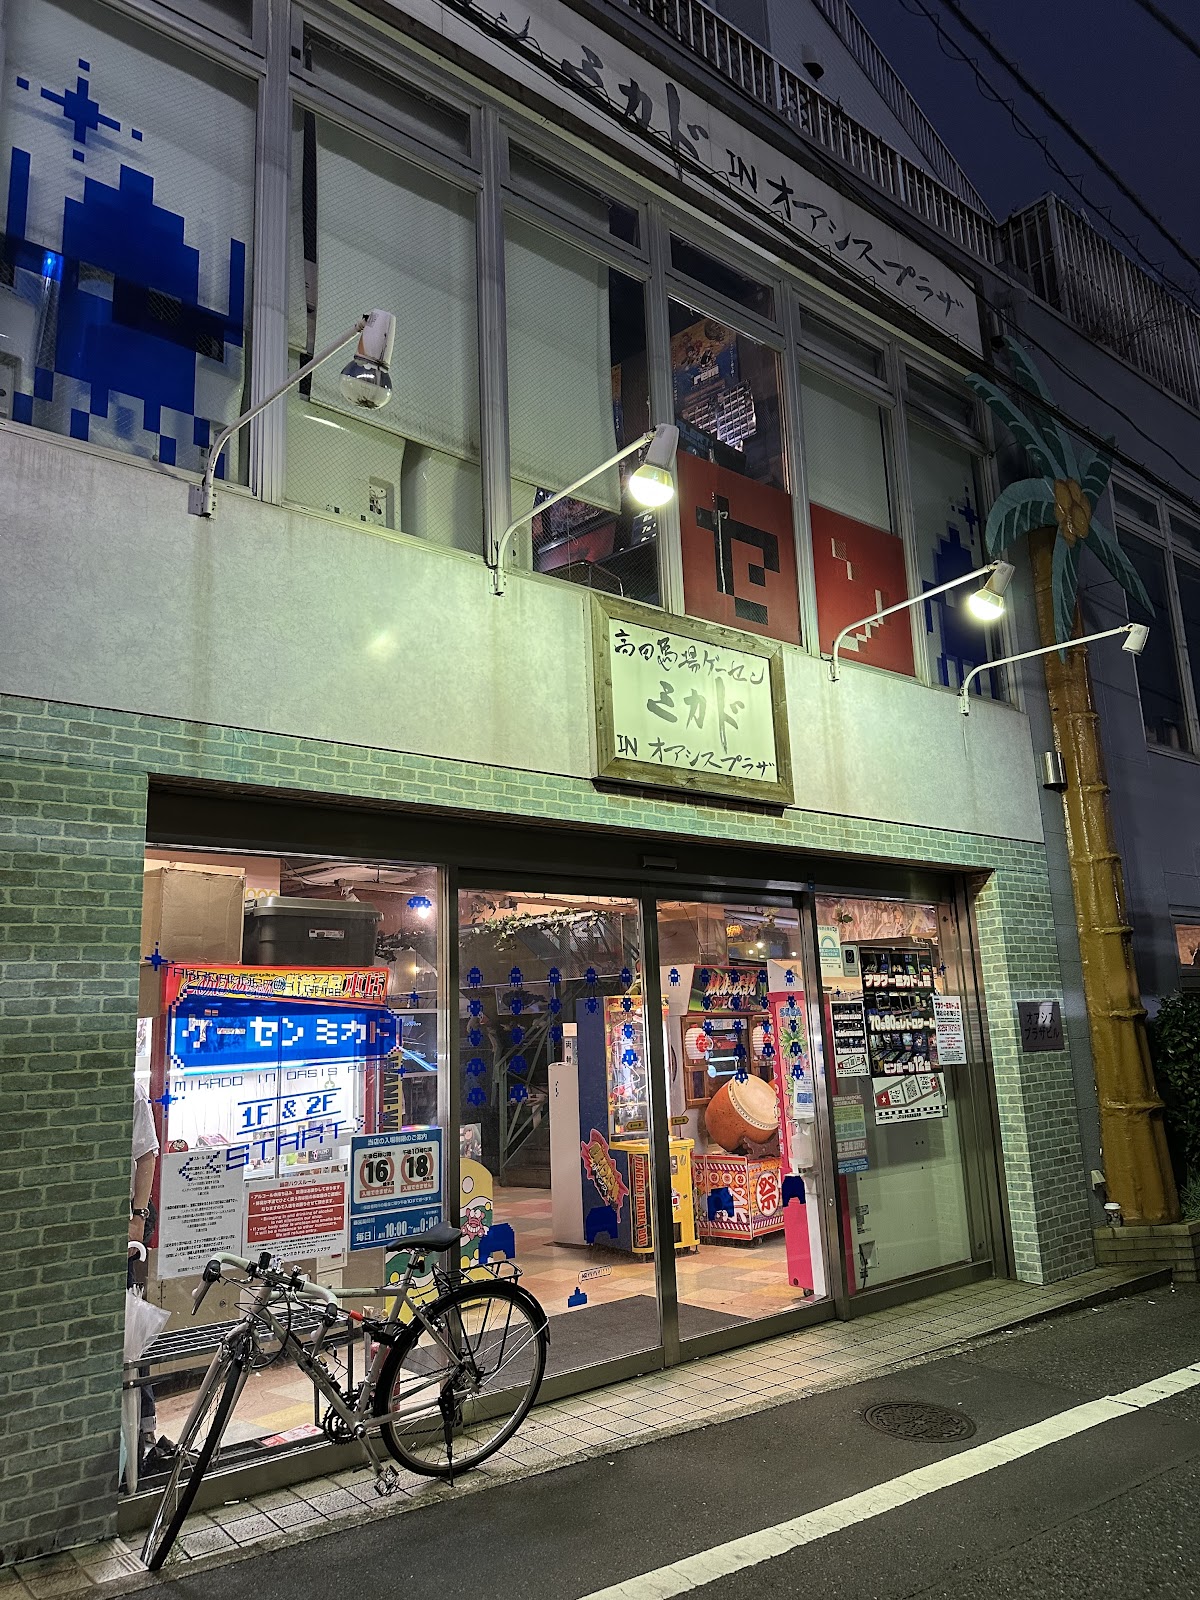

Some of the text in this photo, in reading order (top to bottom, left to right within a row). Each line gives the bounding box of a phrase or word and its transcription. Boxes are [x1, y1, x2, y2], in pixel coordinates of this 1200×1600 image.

[561, 45, 964, 317] ミカド IN オアシスプラザ
[614, 629, 765, 685] 高田馬場ゲーセン
[646, 676, 746, 754] ミカド
[616, 734, 776, 778] IN オアシスプラザ
[1024, 1026, 1060, 1040] プラザビル
[1026, 1011, 1056, 1026] オアシス
[174, 1075, 244, 1093] MIKADO
[286, 1067, 338, 1081] OASIS
[242, 1093, 337, 1129] 1F & 2F
[226, 1120, 347, 1171] START
[365, 1159, 389, 1184] 16
[406, 1154, 429, 1179] 18
[635, 1155, 645, 1195] DENGEKI
[636, 1196, 648, 1226] IRAIRA
[356, 1231, 372, 1242] 毎日
